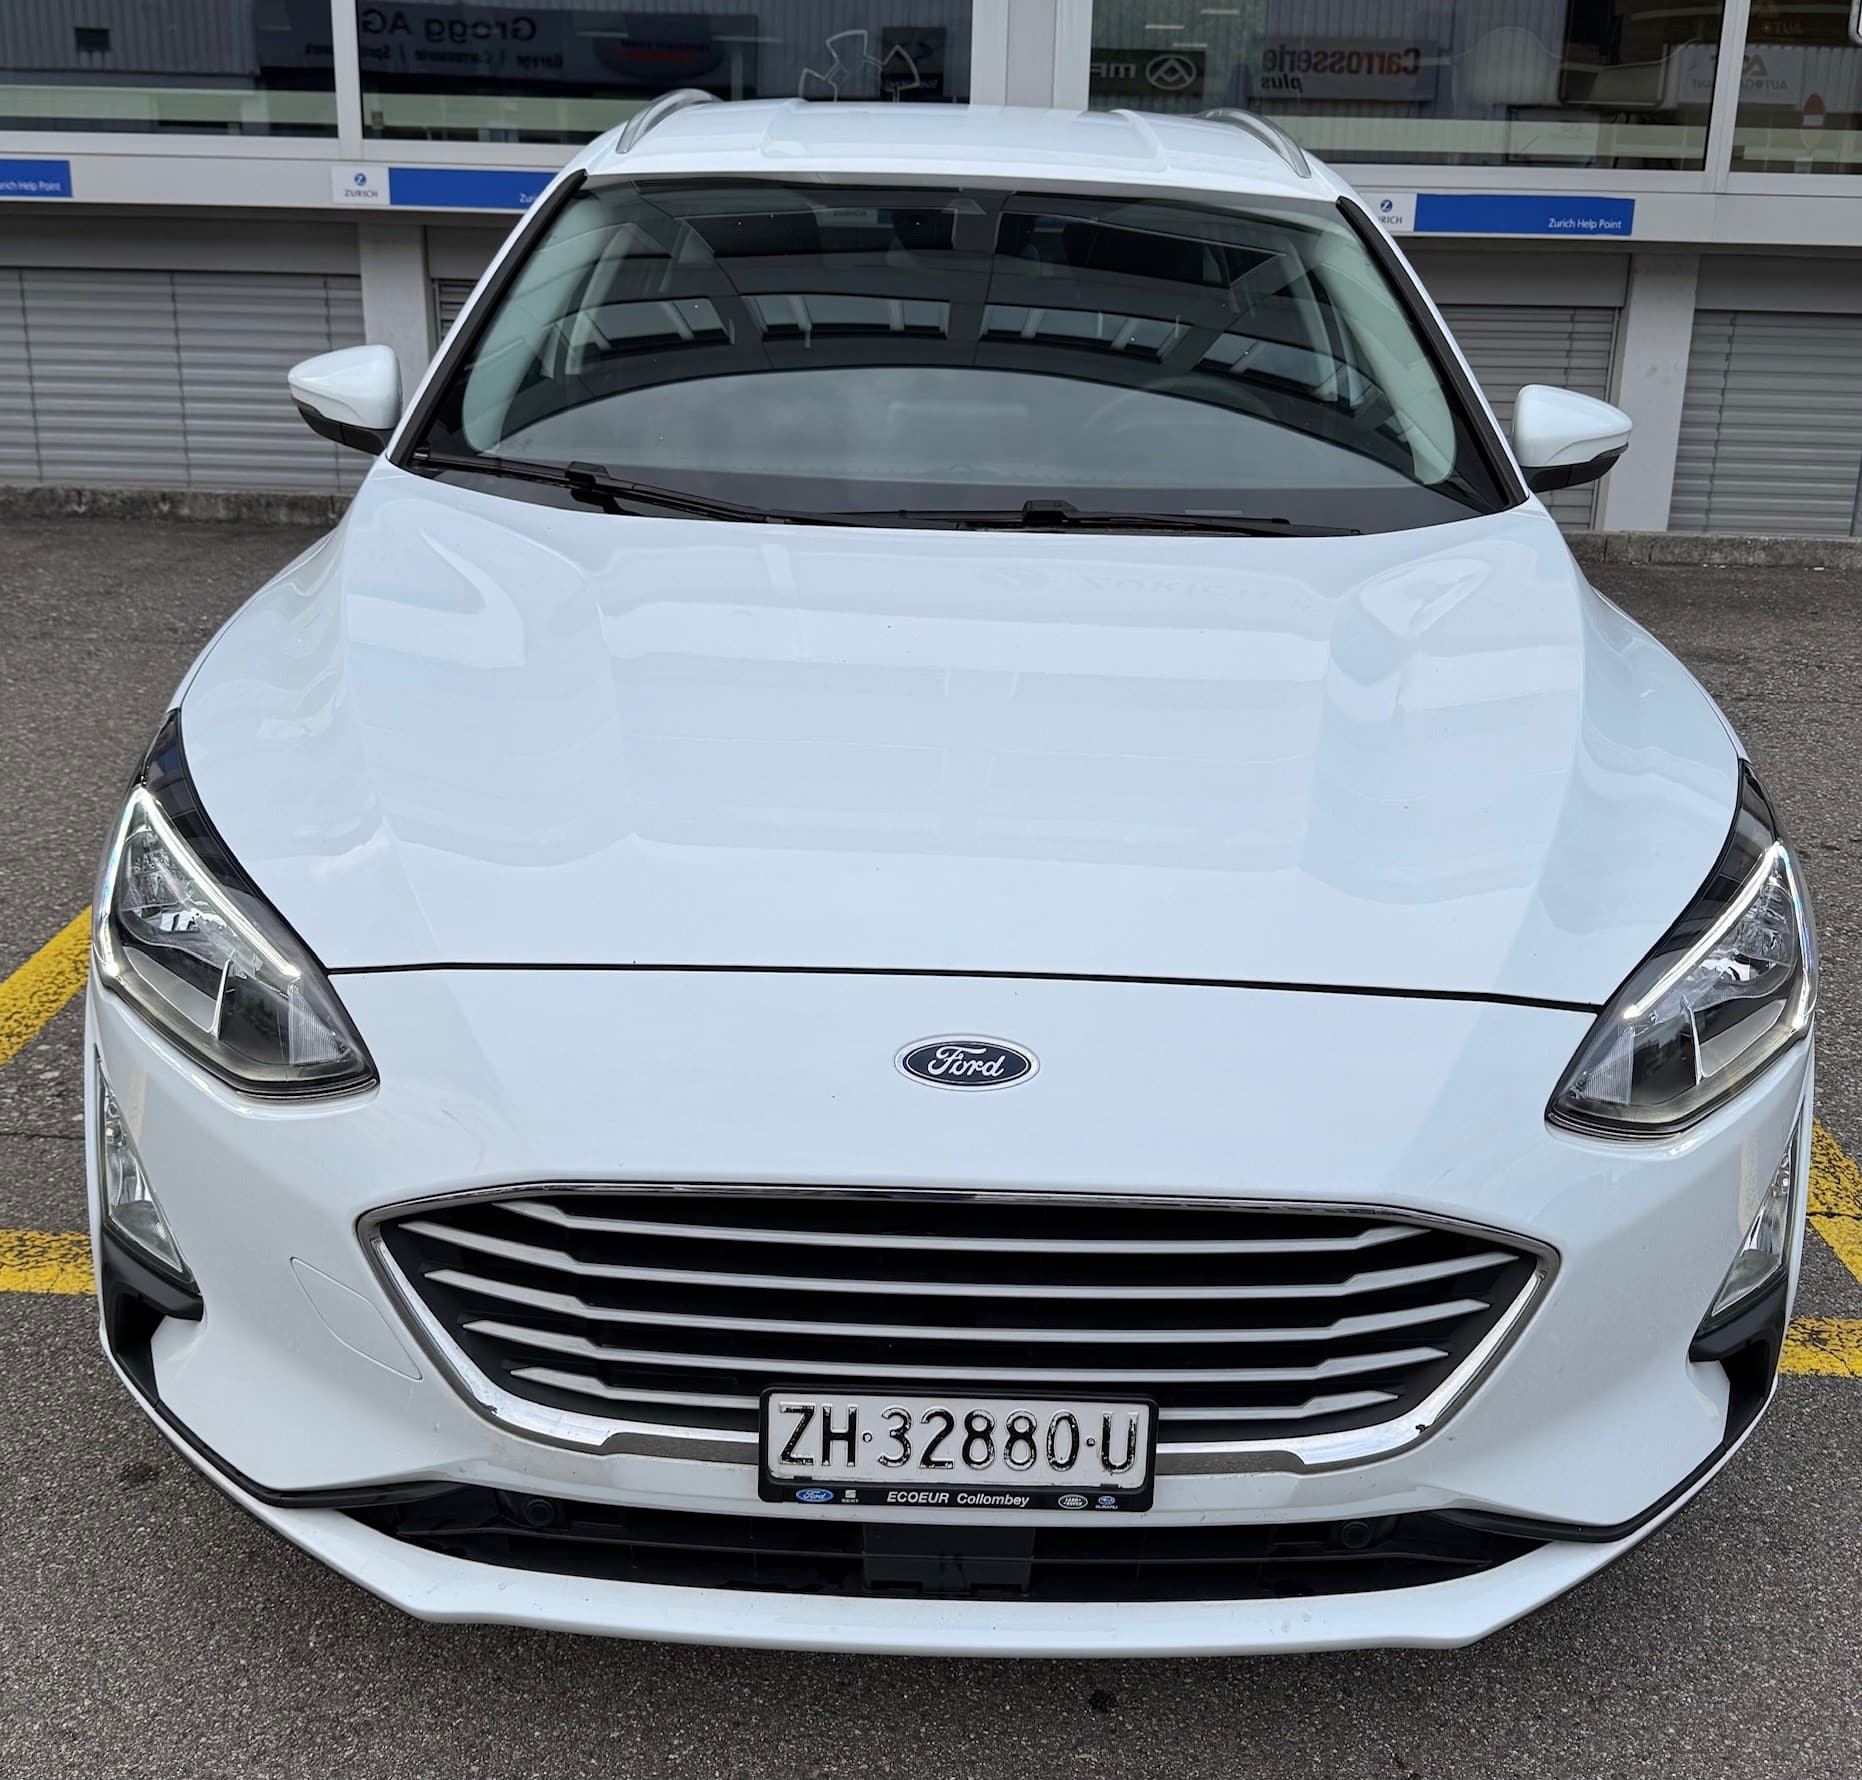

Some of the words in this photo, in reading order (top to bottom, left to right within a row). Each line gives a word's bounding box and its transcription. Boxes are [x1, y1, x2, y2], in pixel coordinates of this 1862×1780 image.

[39, 180, 61, 192] Point
[344, 188, 379, 198] ZURICH
[1378, 216, 1403, 225] RICH
[1548, 218, 1576, 229] Zurich
[1577, 218, 1597, 231] Help
[1599, 219, 1622, 230] Point
[927, 1045, 1006, 1077] Ford
[886, 1491, 950, 1504] ECOEUR
[956, 1492, 1030, 1508] Collombey
